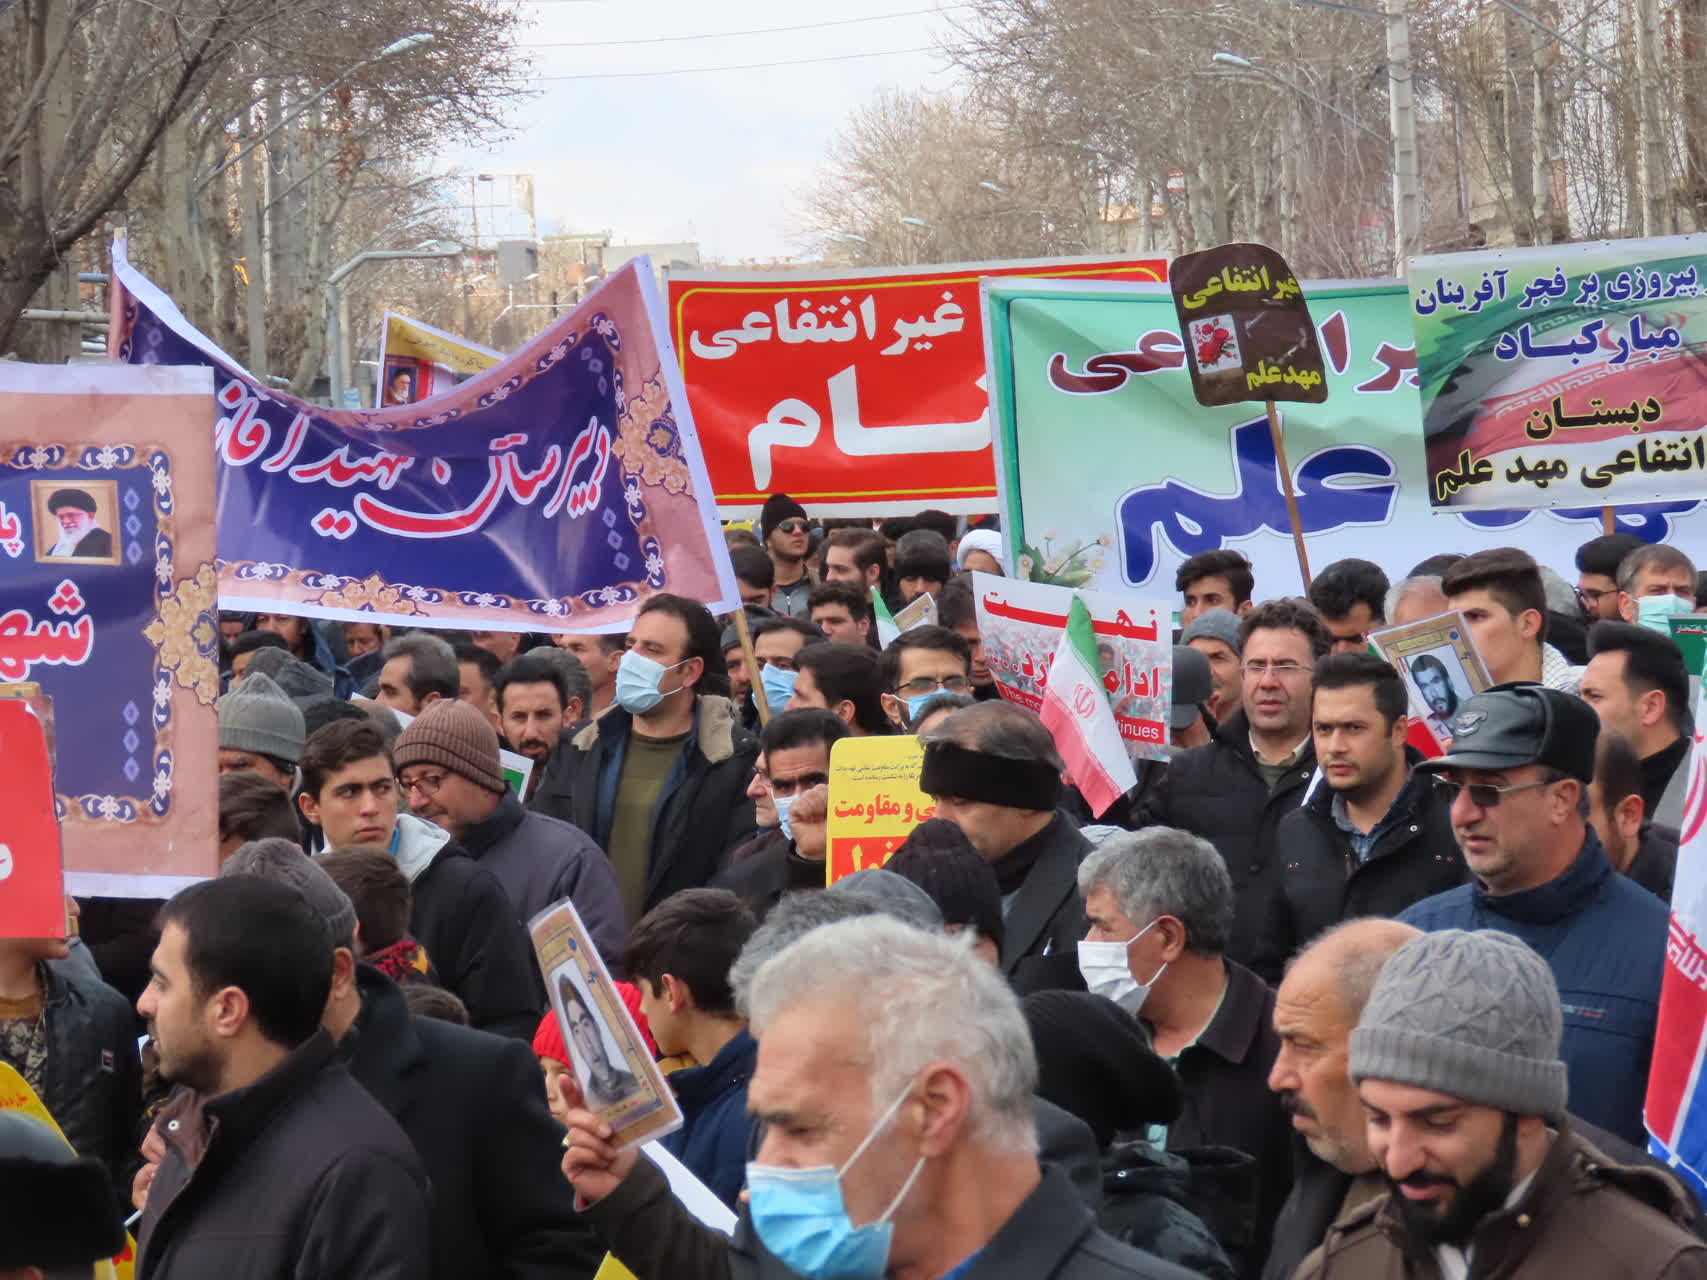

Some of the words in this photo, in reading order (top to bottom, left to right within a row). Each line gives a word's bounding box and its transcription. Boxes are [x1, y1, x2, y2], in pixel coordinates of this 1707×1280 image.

[1182, 264, 1271, 309] انتفاعی
[1415, 268, 1510, 316] آفرینان
[1518, 266, 1568, 310] فجر
[1575, 270, 1600, 306] بر
[1606, 264, 1698, 300] پیروزی
[690, 294, 877, 360] انتفاعی
[880, 291, 965, 356] غیر
[1246, 359, 1282, 391] علم
[1283, 364, 1322, 391] مهد
[1525, 396, 1662, 439] دبستان
[1436, 449, 1495, 500] علم
[1505, 454, 1569, 489] مهد
[1580, 435, 1706, 489] انتفاعی
[1115, 410, 1400, 588] علم
[1120, 719, 1160, 739] inues
[834, 794, 901, 824] مقاومت
